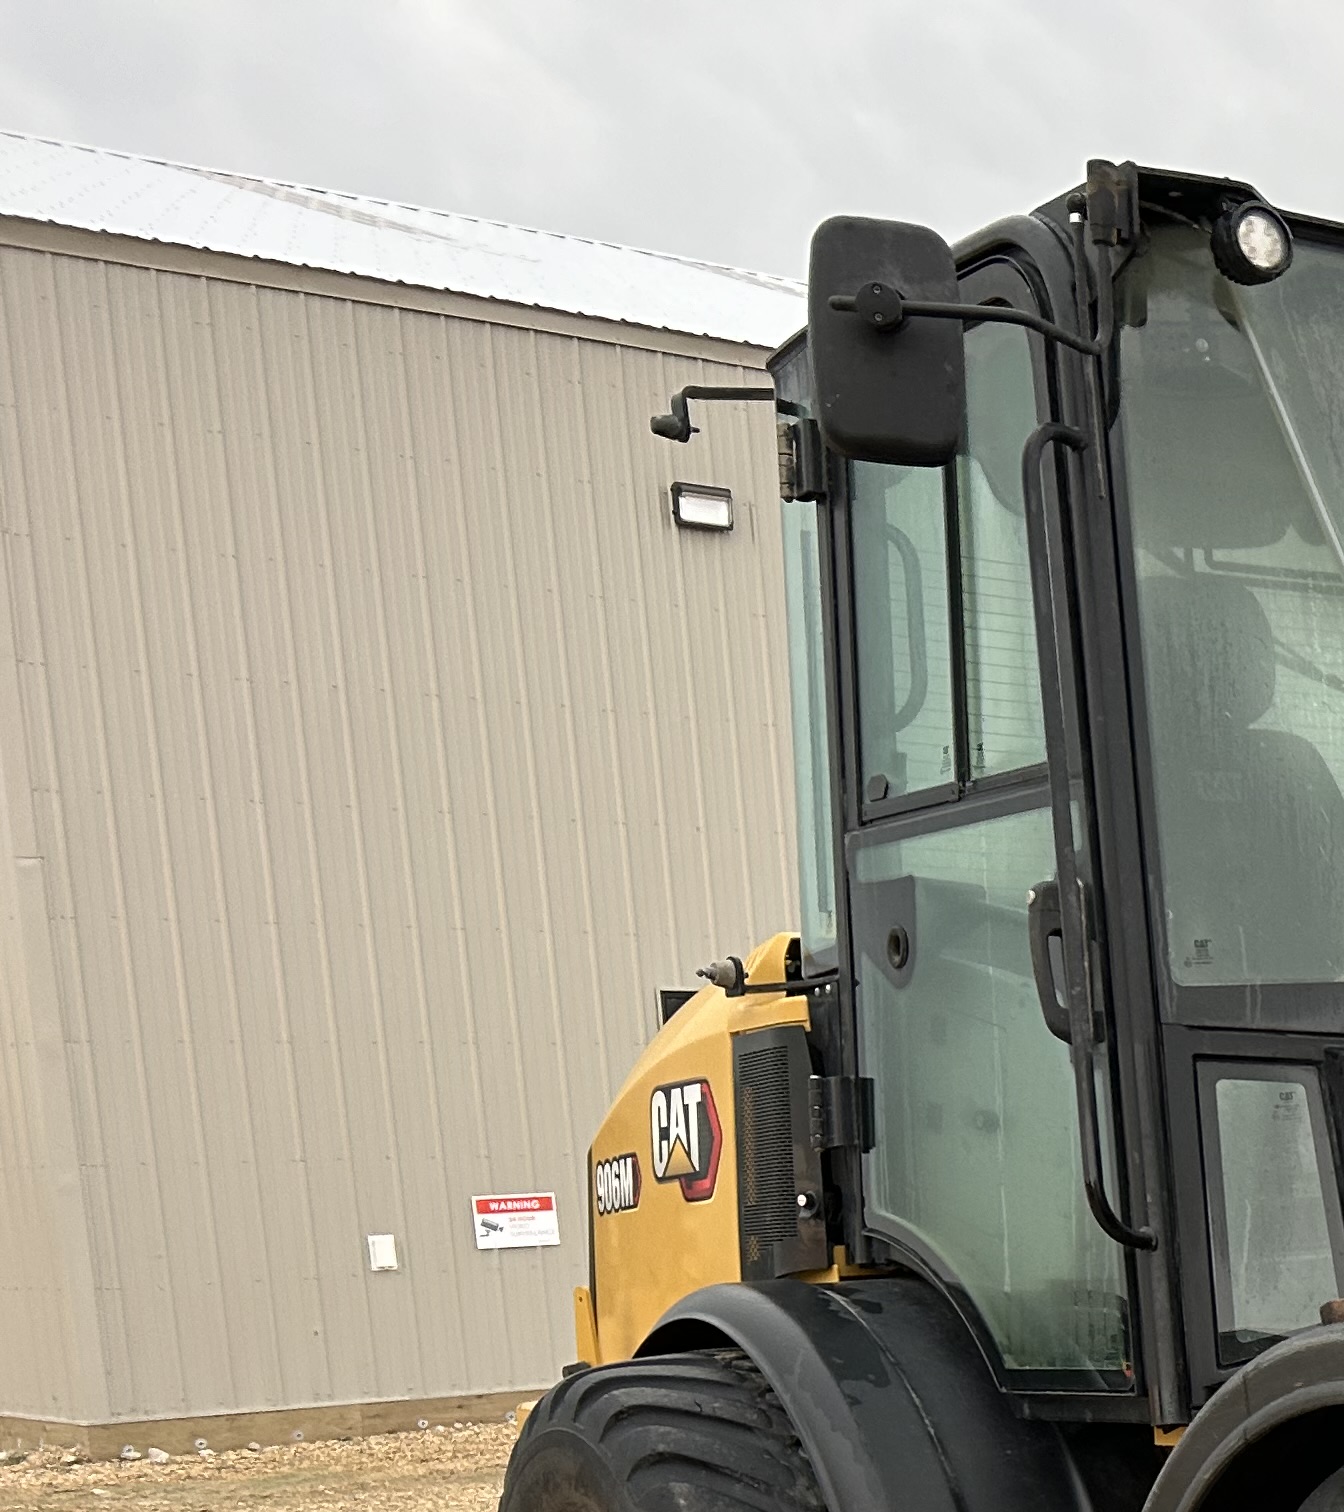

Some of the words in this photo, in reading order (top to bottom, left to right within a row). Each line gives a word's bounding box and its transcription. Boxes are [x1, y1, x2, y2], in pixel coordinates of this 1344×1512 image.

[651, 1083, 702, 1178] CAT
[488, 1199, 541, 1211] WARNING
[596, 1157, 634, 1213] 906M
